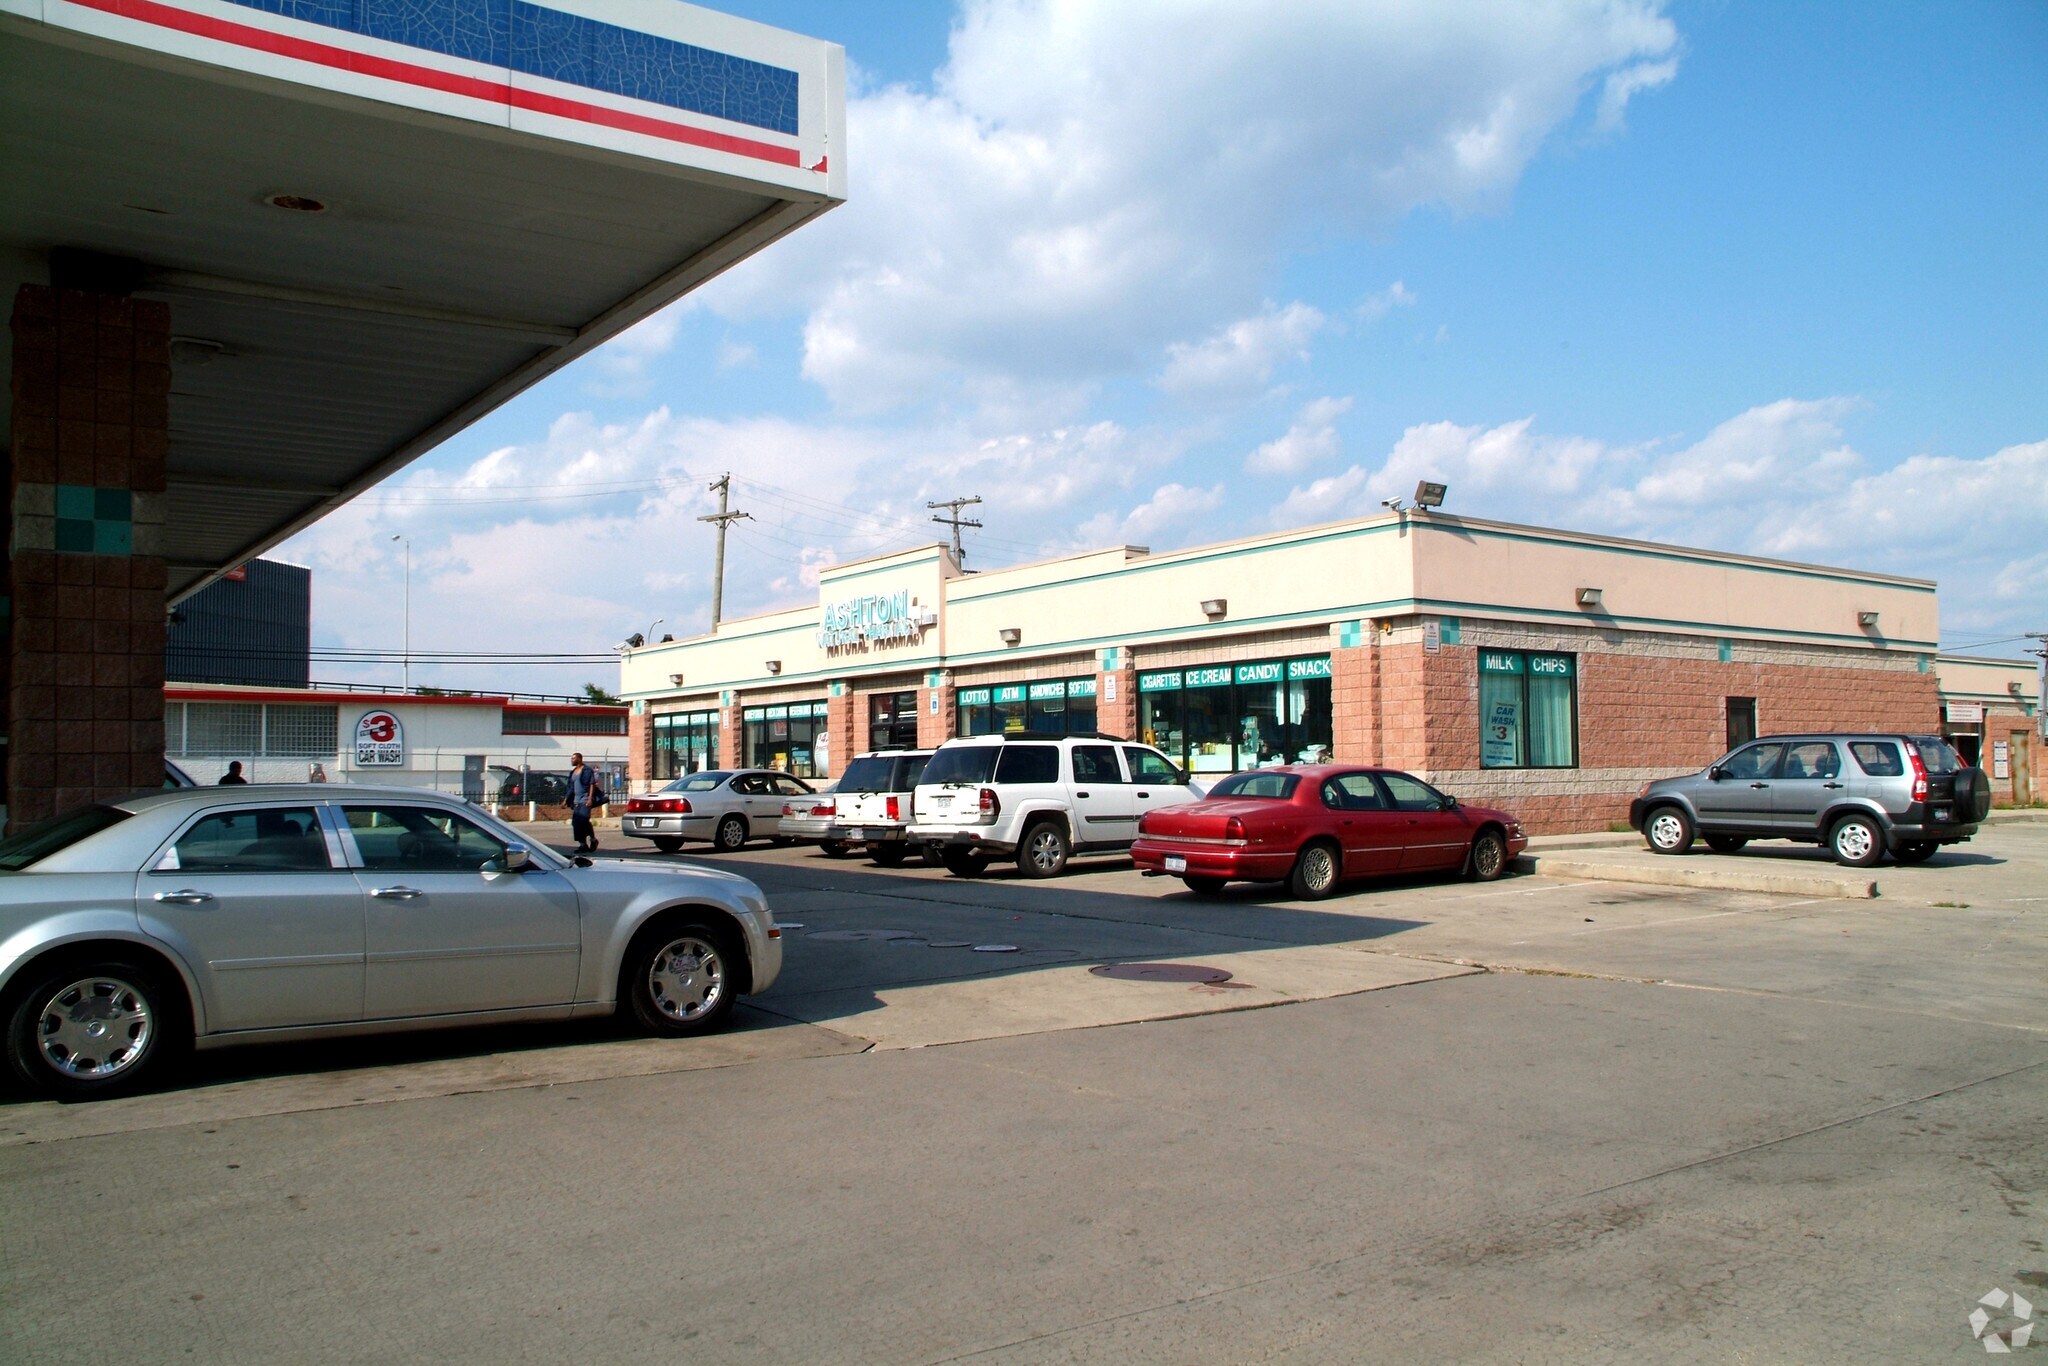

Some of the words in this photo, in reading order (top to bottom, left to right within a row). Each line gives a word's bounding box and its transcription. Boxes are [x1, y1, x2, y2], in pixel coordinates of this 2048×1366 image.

[824, 589, 908, 631] ASHTON
[1486, 655, 1514, 670] MILK
[1533, 657, 1567, 673] CHIPS
[1185, 671, 1199, 685] ICE
[1201, 668, 1231, 684] CREAM
[1239, 663, 1281, 681] CANDY
[1068, 681, 1084, 695] SOFT
[1142, 672, 1181, 689] CIGARETTES
[961, 690, 989, 703] LOTTO
[1001, 686, 1019, 700] ATM
[1030, 682, 1065, 698] SANDWICHES
[1496, 706, 1515, 716] CAR
[1491, 716, 1516, 726] WASH
[358, 750, 375, 763] CAR
[378, 750, 401, 763] WASH
